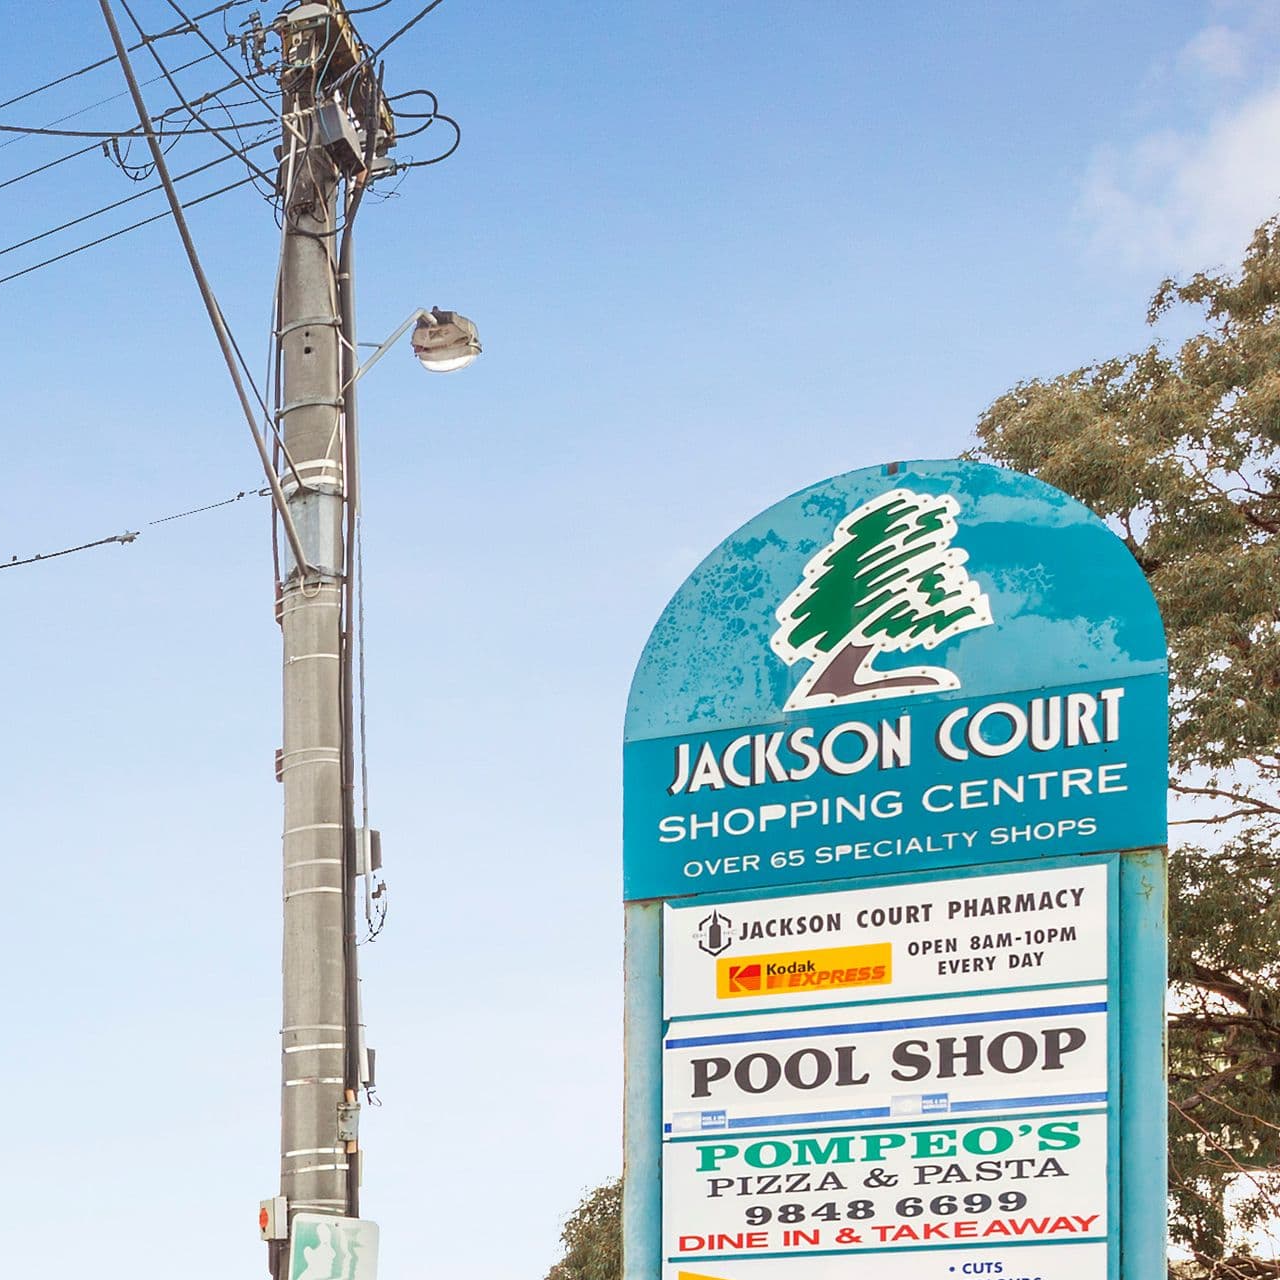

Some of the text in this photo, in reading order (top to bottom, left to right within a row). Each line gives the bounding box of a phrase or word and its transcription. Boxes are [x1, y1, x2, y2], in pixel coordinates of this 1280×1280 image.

[667, 687, 1125, 796] JACKSON COURT
[659, 763, 1129, 844] SHOPPING CENTRE
[683, 817, 1097, 878] OVER 65 SPECIALTY SHOPS
[739, 888, 1085, 941] JACKSON COURT PHARMACY
[907, 926, 1077, 957] OPEN 8AM-10PM
[766, 960, 816, 976] Kodak
[789, 965, 885, 988] EXPRESS
[937, 951, 1045, 976] EVERY DAY
[690, 1027, 1087, 1099] POOL SHOP
[695, 1121, 1080, 1173] POMPEO'S
[707, 1157, 1069, 1198] PIZZA & PASTA
[745, 1191, 1027, 1227] 9848 6699
[679, 1214, 1101, 1252] DINE IN & TAKEAWAY
[962, 1262, 1004, 1275] CUTS
